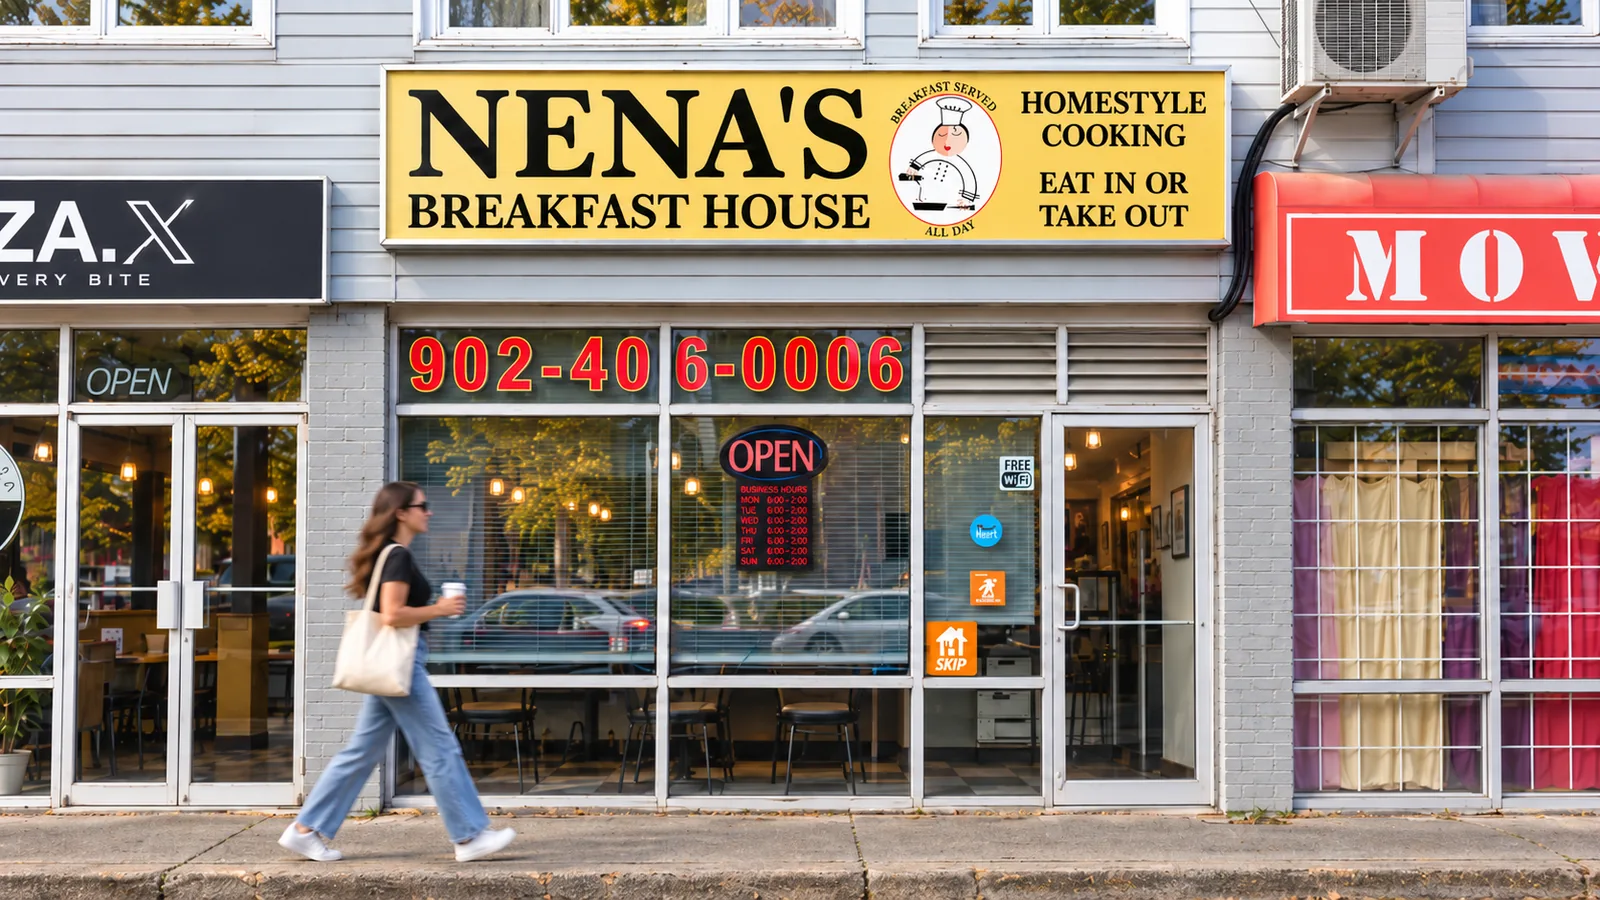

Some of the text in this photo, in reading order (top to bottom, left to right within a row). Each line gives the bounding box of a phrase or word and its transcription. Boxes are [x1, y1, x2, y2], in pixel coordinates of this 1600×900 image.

[890, 80, 998, 124] BREAKFAST SERVED
[1020, 90, 1207, 115] HOMESTYLE
[408, 85, 868, 180] NENA'S
[1041, 123, 1187, 148] COOKING
[1039, 171, 1189, 195] EAT IN OR
[408, 193, 871, 230] BREAKFAST HOUSE
[1038, 204, 1189, 228] TAKE OUT
[924, 219, 976, 238] ALL DAY
[89, 273, 150, 286] BITE
[87, 367, 172, 395] OPEN
[728, 439, 814, 473] OPEN
[1004, 459, 1031, 471] FREE
[740, 485, 808, 494] BUSINESS HOURS
[740, 495, 760, 504] MON
[740, 505, 757, 514] TUE
[740, 515, 759, 525] WED
[740, 526, 757, 535] THU
[740, 536, 754, 545] FRI
[740, 546, 756, 555] SAT
[740, 556, 758, 565] SUN
[935, 657, 967, 671] SKIP
